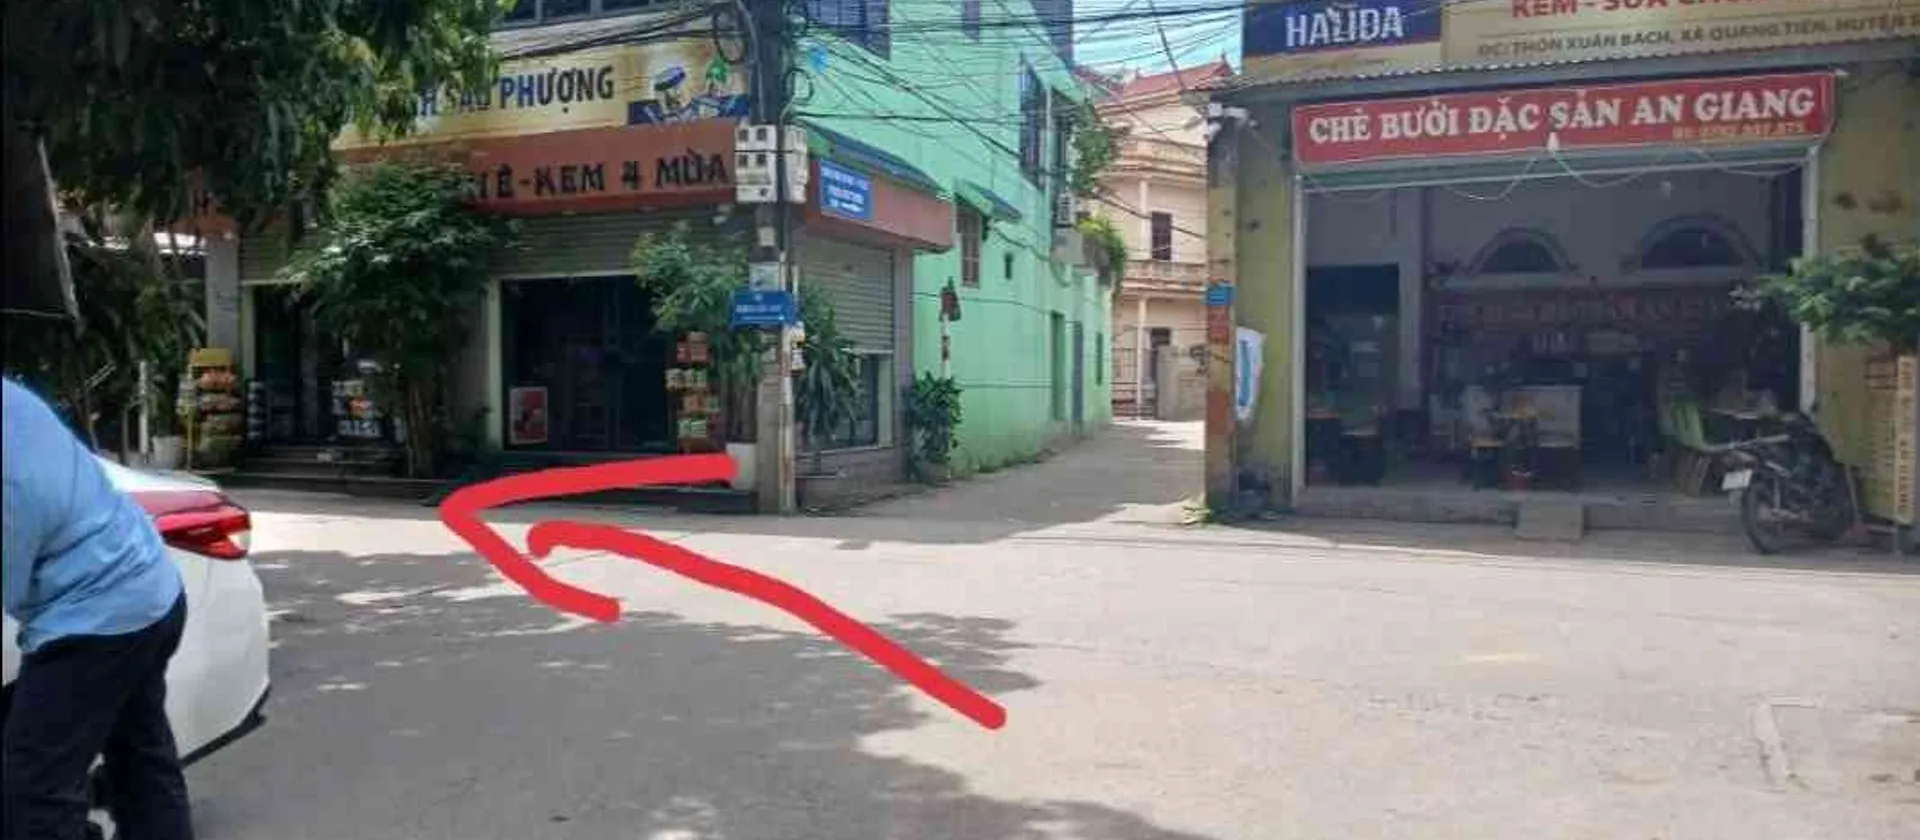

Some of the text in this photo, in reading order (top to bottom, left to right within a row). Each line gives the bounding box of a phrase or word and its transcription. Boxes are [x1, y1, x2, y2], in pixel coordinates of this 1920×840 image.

[1286, 6, 1404, 47] HALIDA
[499, 65, 614, 113] PHƯỢNG
[1309, 87, 1815, 143] CHÈ BƯỞI ĐẶC SẢN AN GIANG
[621, 161, 642, 190] 4
[656, 147, 731, 188] MÙA
